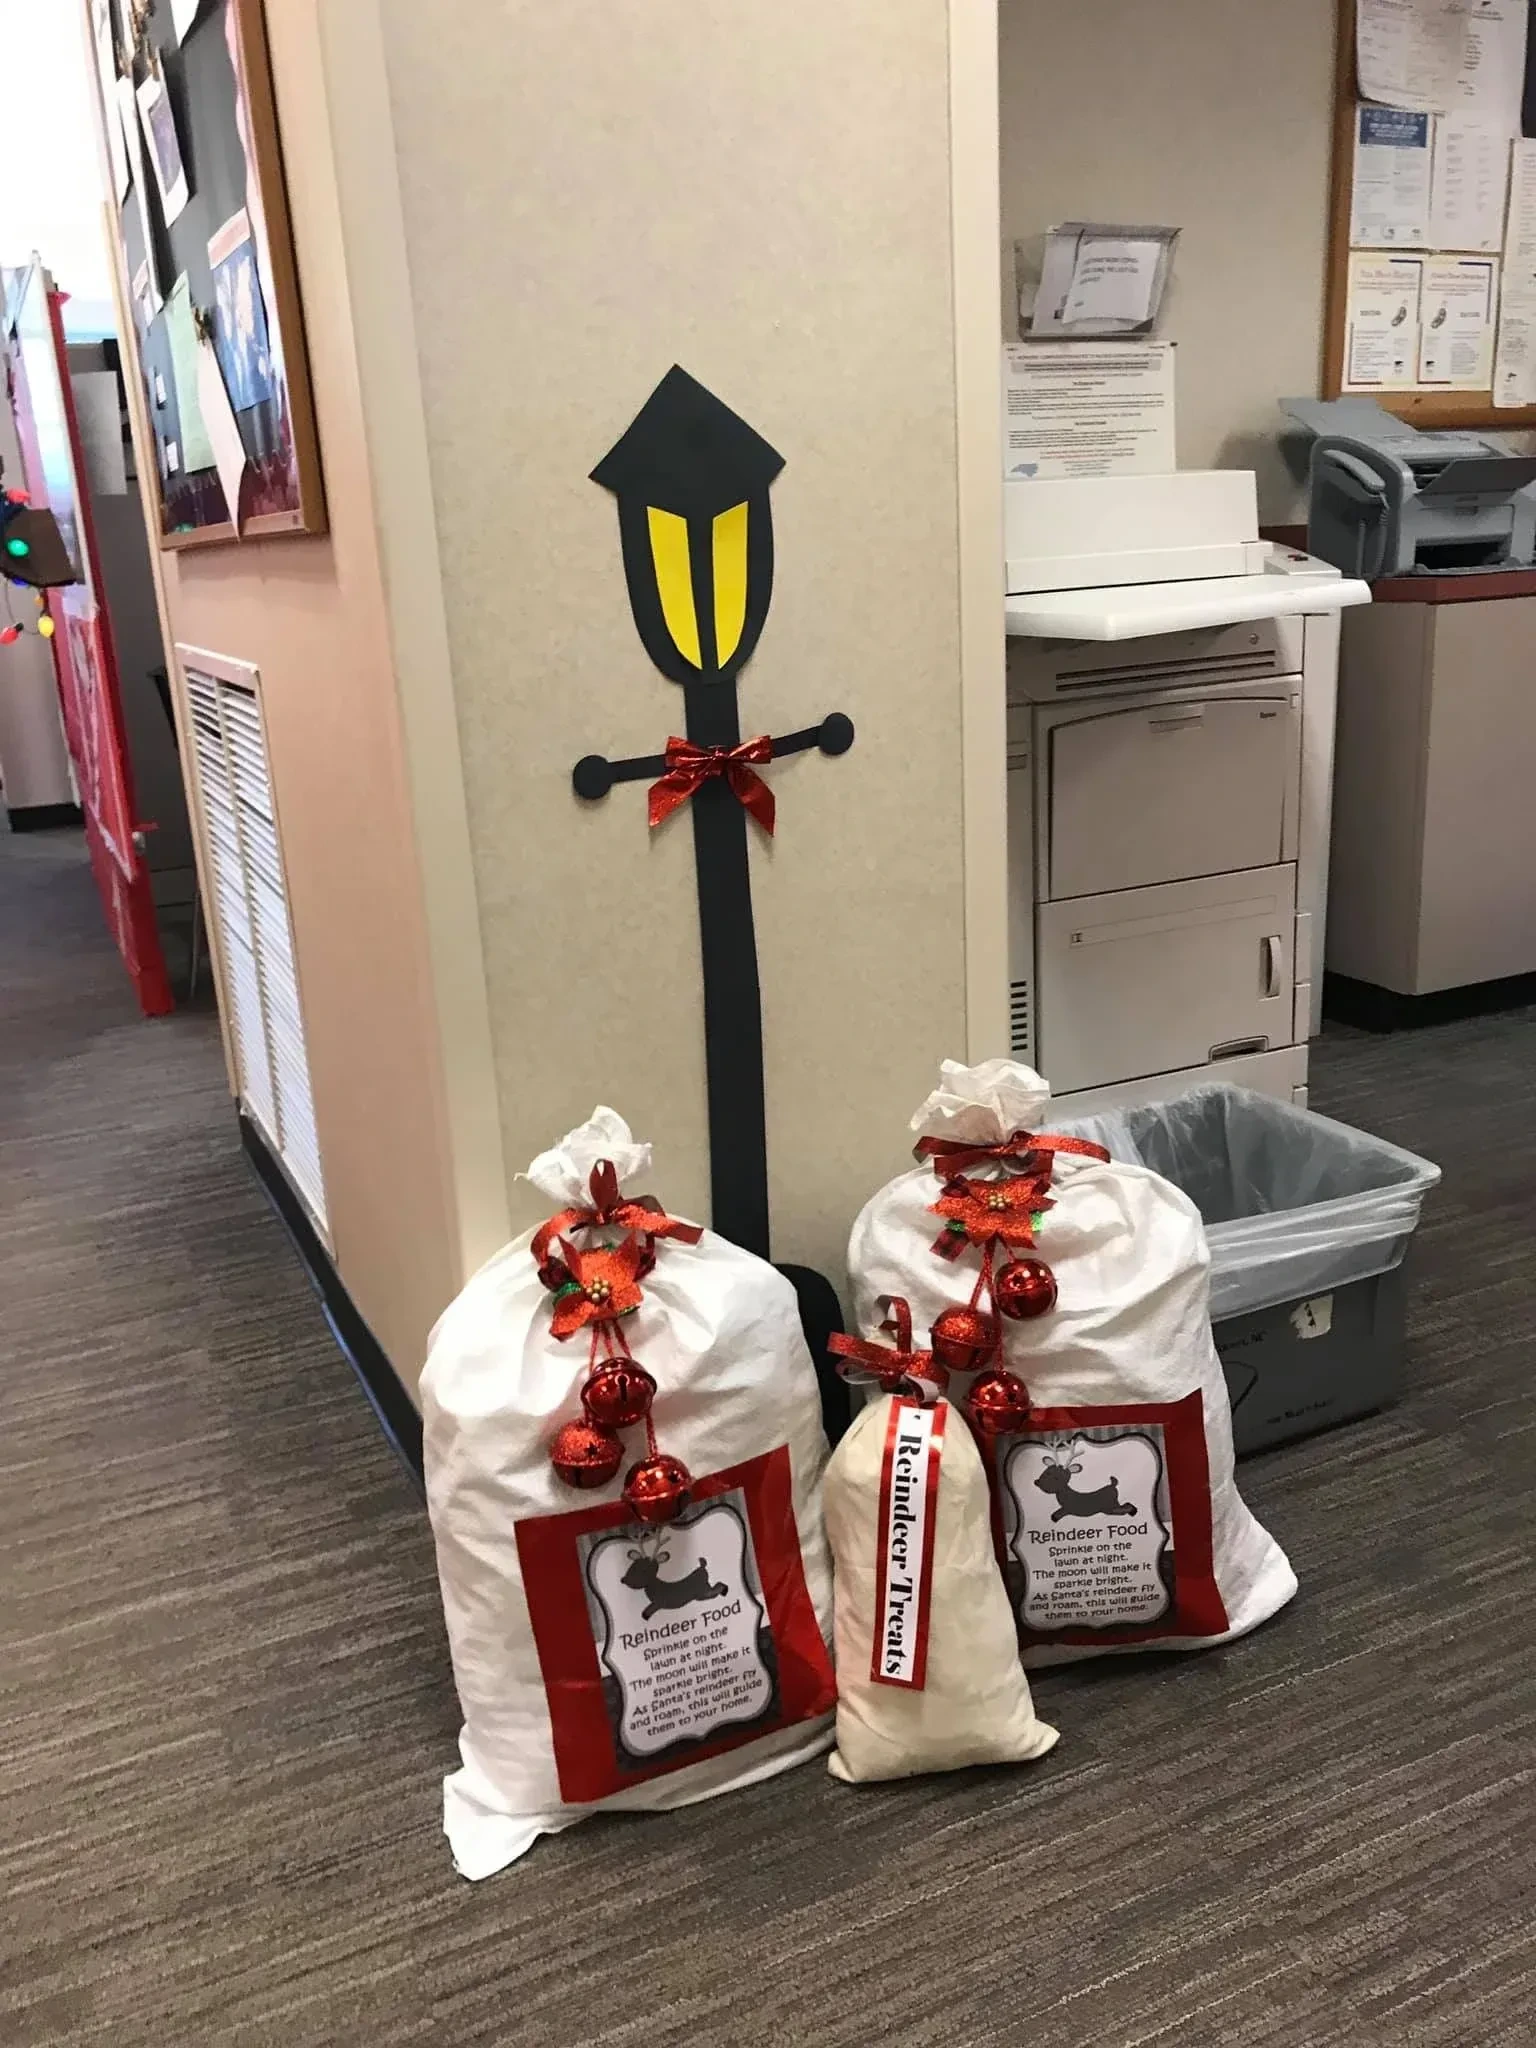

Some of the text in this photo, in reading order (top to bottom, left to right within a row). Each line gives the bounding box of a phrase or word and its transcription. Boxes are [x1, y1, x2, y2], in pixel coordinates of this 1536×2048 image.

[1028, 1522, 1148, 1544] Reindeer Food
[885, 1434, 921, 1675] Reindeer Treats
[1049, 1544, 1093, 1557] Sprinkle
[1114, 1541, 1132, 1550] the
[1054, 1553, 1128, 1567] lawn at night.
[1032, 1562, 1152, 1580] The moon will make it
[1054, 1575, 1132, 1589] sparkle bright.
[1030, 1602, 1049, 1611] and
[1086, 1598, 1106, 1607] this
[1109, 1596, 1128, 1605] will
[1131, 1594, 1160, 1604] guide
[1033, 1592, 1048, 1601] As
[1051, 1589, 1089, 1601] Santa's
[1094, 1586, 1137, 1596] reindeer
[620, 1599, 741, 1650] Reindeer Food
[1045, 1610, 1072, 1620] them
[1076, 1610, 1088, 1618] to
[1092, 1608, 1114, 1616] your
[644, 1626, 728, 1661] Sprinkle on the
[651, 1642, 726, 1672] lawn at night.
[630, 1646, 751, 1692] The moon will make it
[653, 1666, 732, 1698] sparkle bright.
[630, 1716, 650, 1730] and
[688, 1698, 708, 1710] this
[712, 1690, 731, 1702] will
[733, 1679, 762, 1696] guide
[633, 1704, 648, 1716] As
[651, 1691, 690, 1712] Santa's
[694, 1675, 739, 1696] reindeer
[647, 1695, 752, 1736] them to your home.
